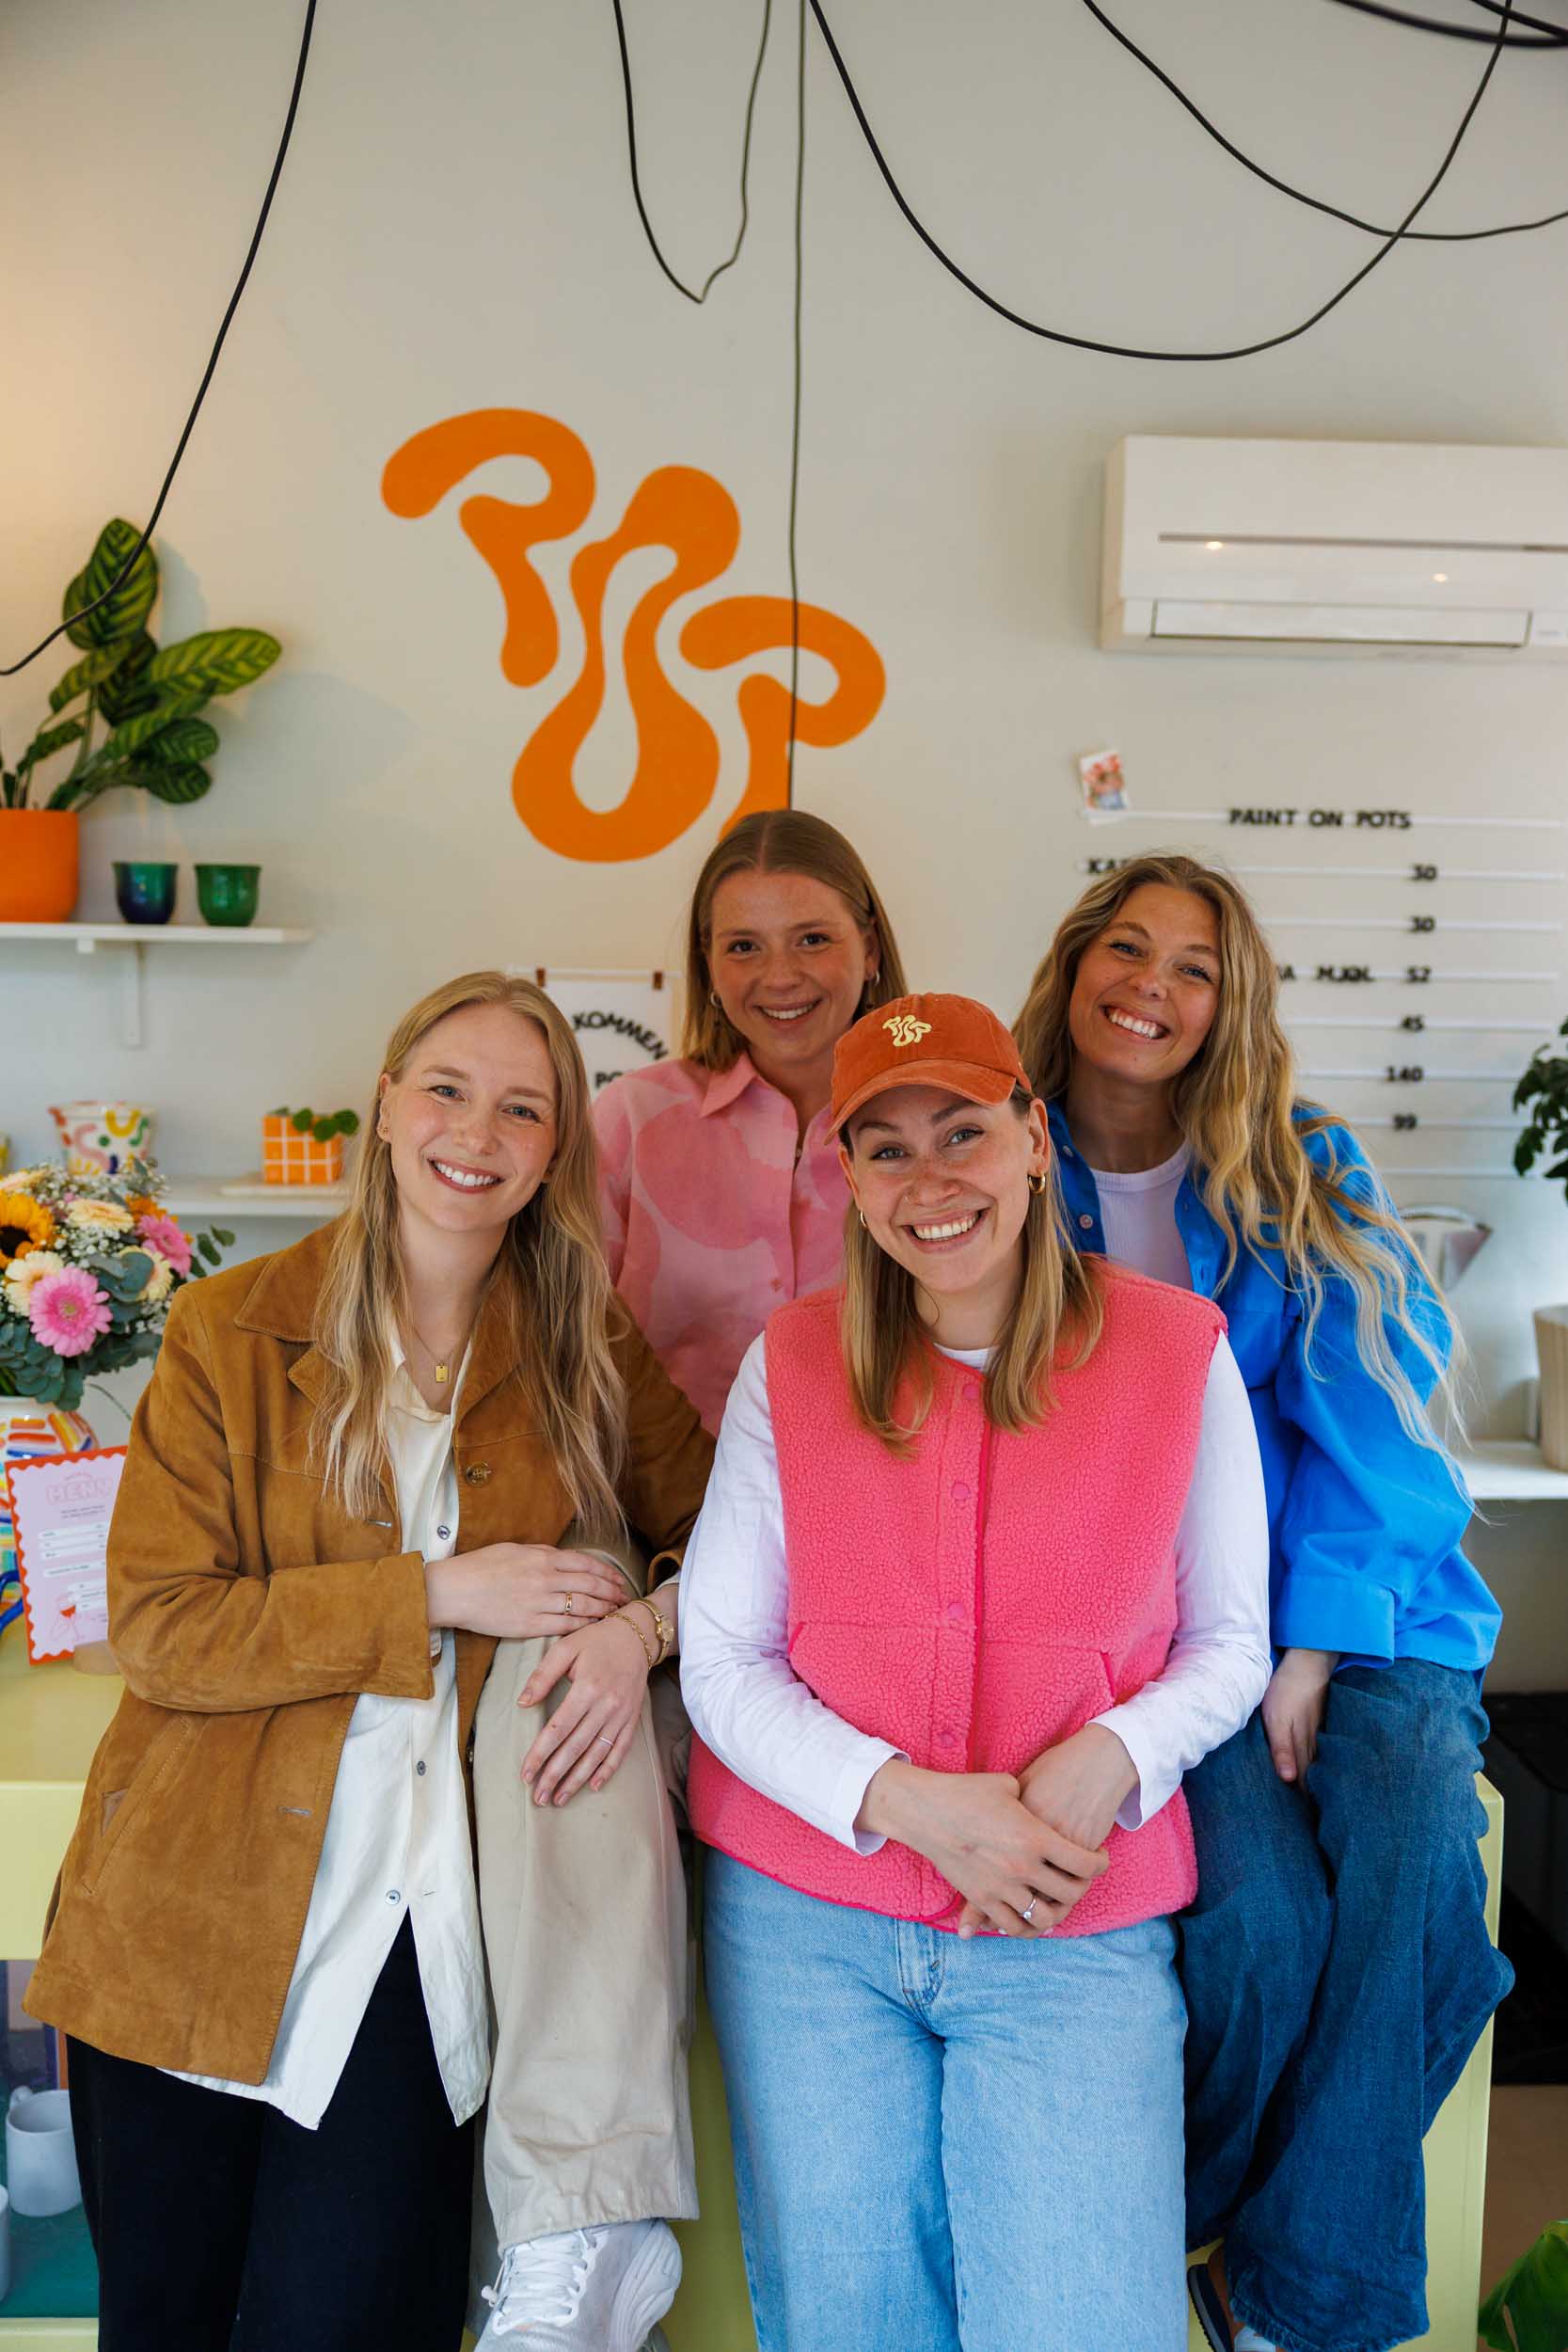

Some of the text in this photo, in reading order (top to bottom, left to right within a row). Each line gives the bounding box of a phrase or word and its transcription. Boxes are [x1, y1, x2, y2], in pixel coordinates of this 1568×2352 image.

[1228, 808, 1411, 829] PAINT ON POTS
[1412, 865, 1436, 882] 30
[1411, 915, 1435, 933] 30
[1402, 1014, 1424, 1033] 45
[1386, 1065, 1423, 1083] 140
